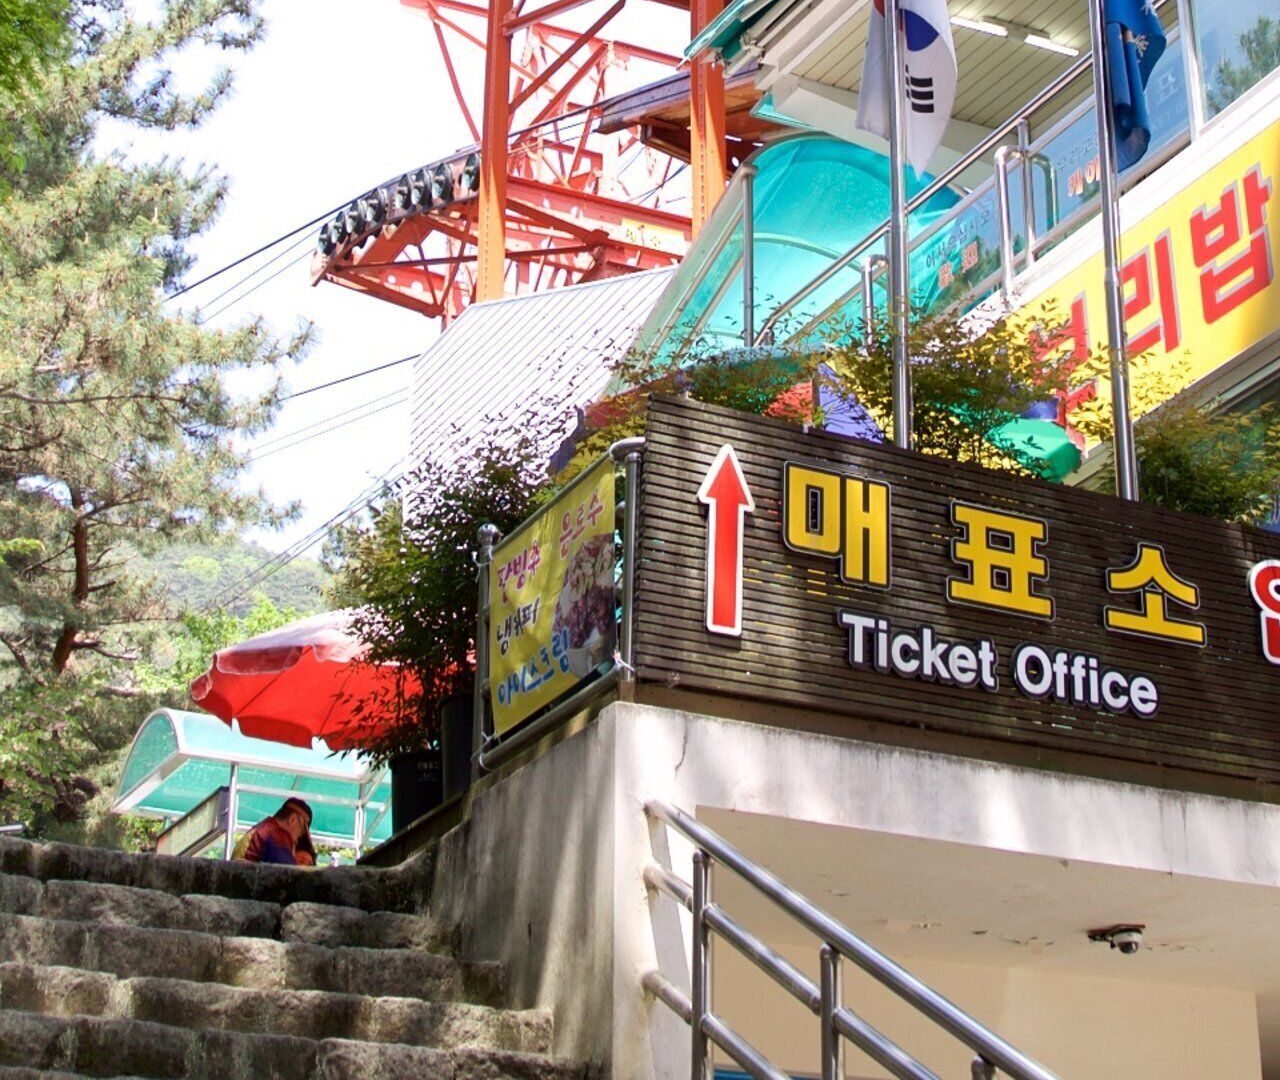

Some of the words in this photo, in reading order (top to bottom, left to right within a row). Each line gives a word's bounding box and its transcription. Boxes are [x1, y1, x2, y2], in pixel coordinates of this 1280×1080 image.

[782, 459, 1207, 647] 매표소
[838, 607, 999, 692] Ticket
[1013, 641, 1162, 719] Office
